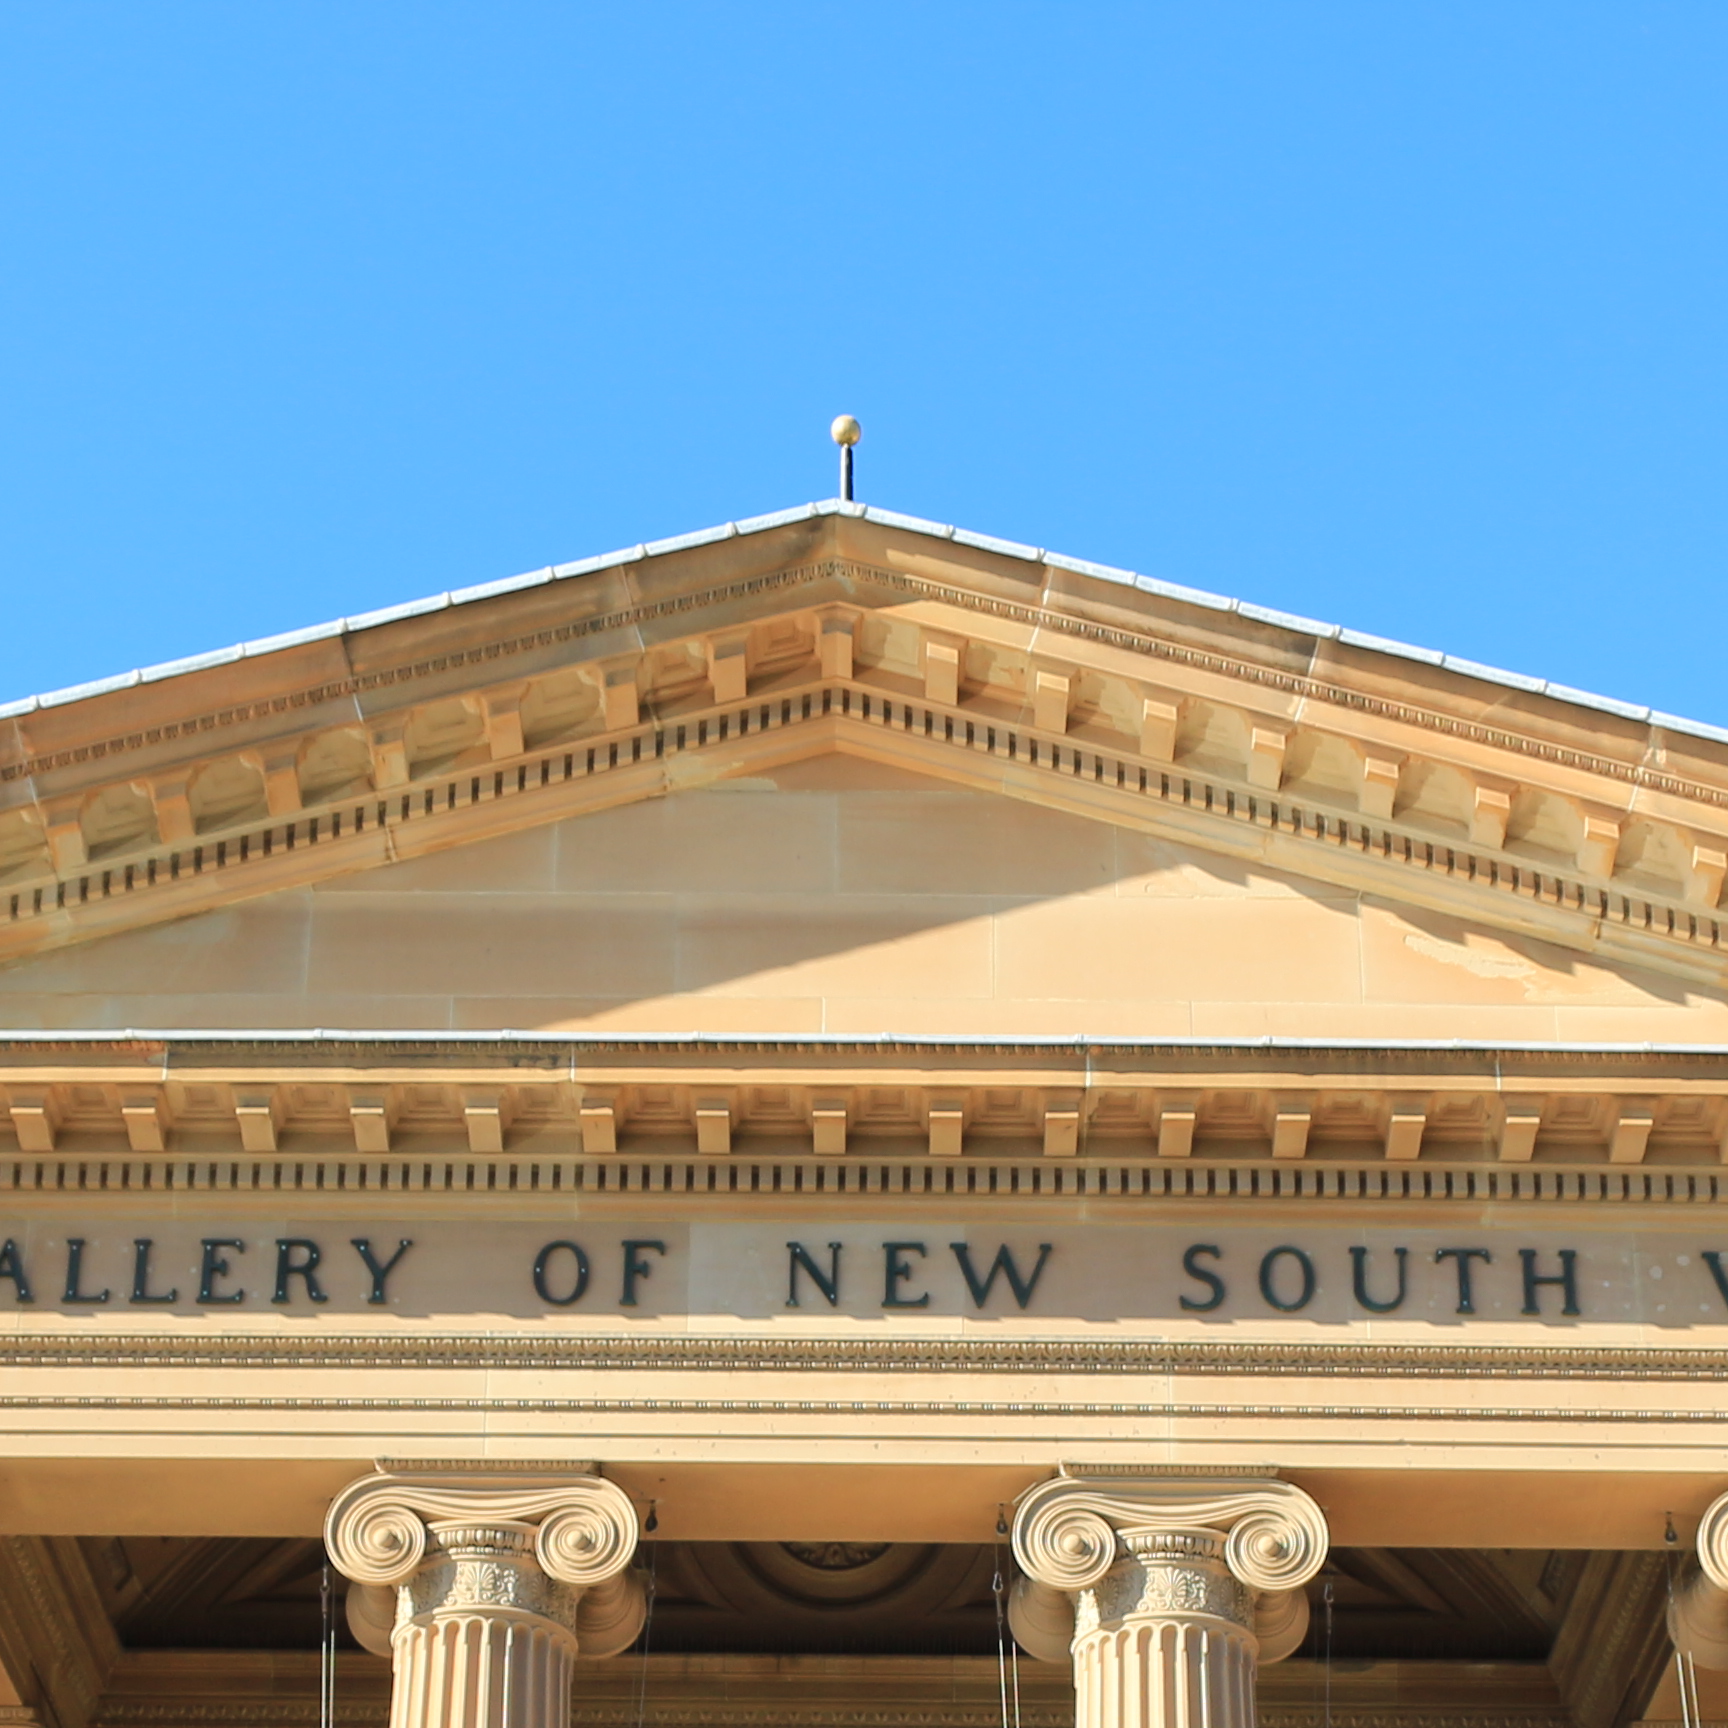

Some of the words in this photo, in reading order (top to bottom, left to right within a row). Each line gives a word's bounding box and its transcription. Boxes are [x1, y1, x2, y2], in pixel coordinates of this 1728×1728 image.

[533, 1239, 667, 1306] OF
[786, 1242, 1053, 1309] NEW
[1179, 1244, 1580, 1316] SOUTH
